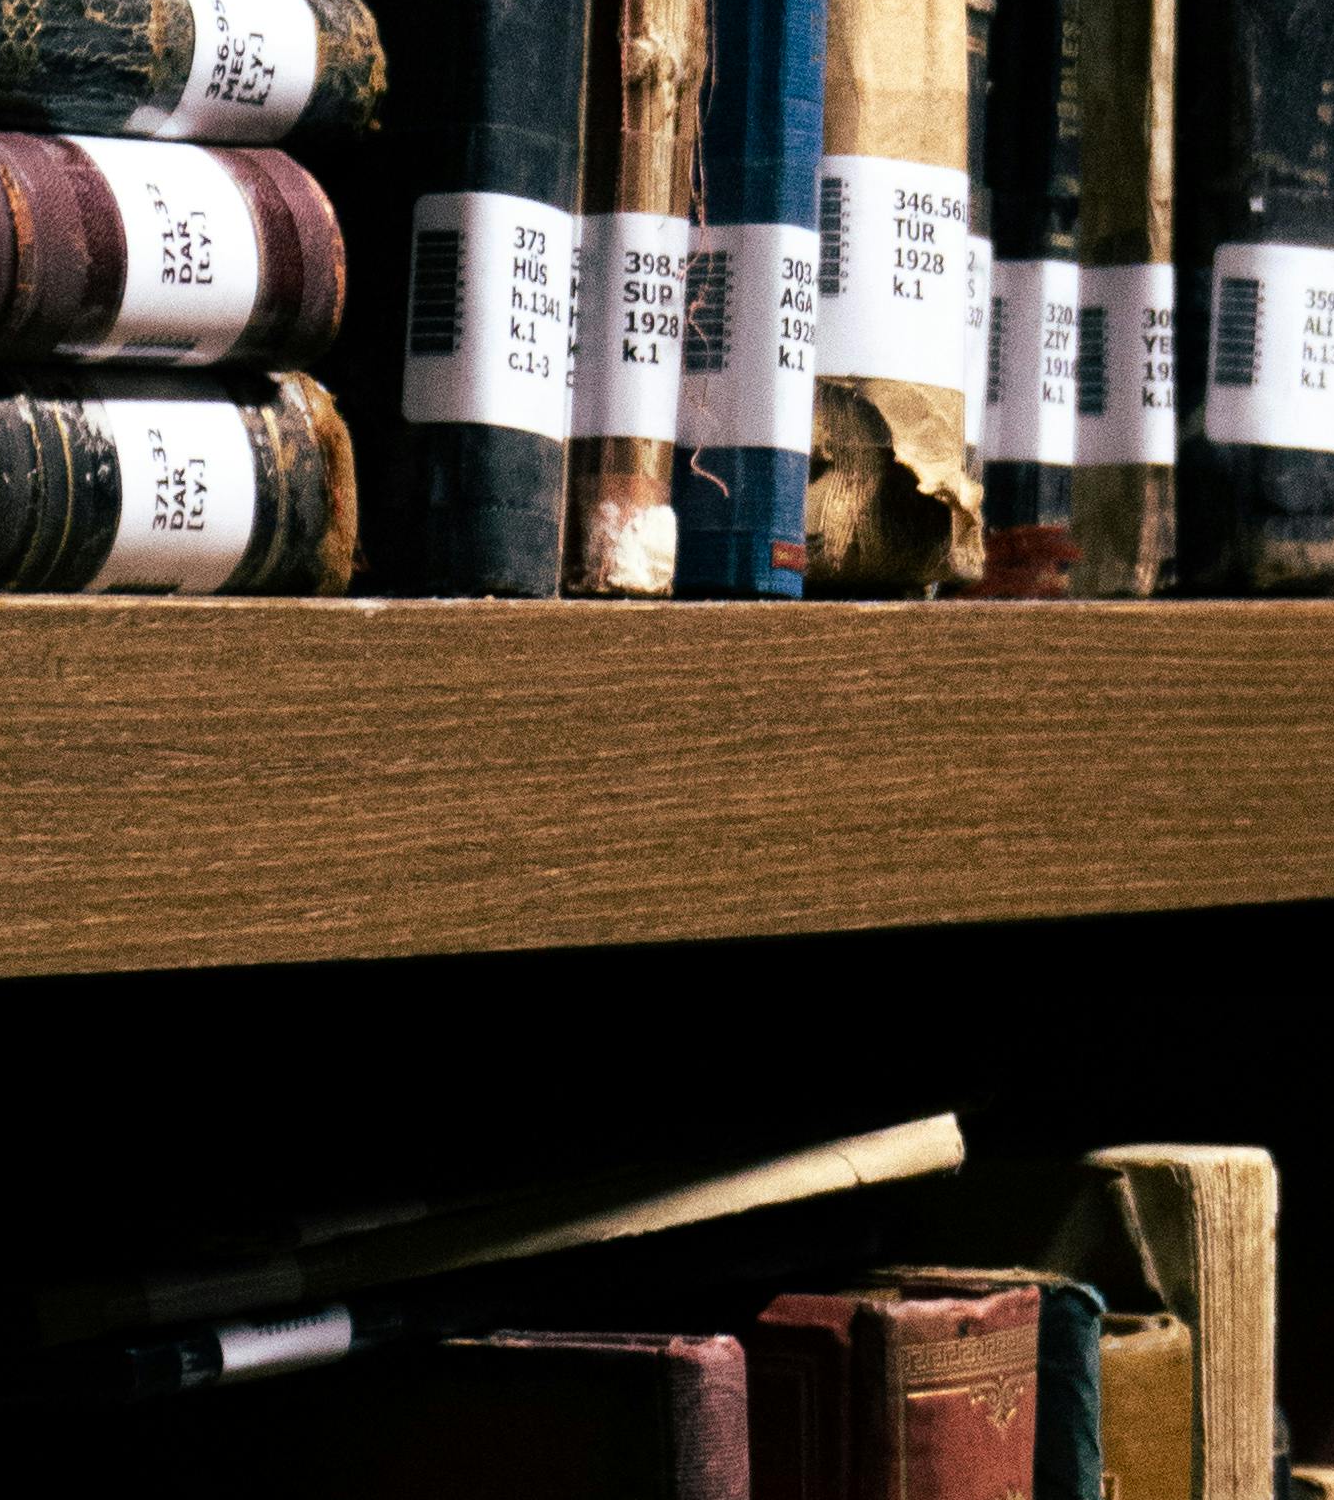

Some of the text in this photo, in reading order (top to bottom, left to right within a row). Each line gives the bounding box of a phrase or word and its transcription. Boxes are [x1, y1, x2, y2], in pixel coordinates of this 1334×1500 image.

[220, 37, 246, 102] MEC
[514, 226, 547, 255] 373
[893, 214, 937, 246] TÜR
[176, 220, 193, 285] DAR
[893, 247, 946, 276] 1928
[512, 255, 548, 287] HÜS
[622, 281, 675, 307] SUP
[779, 283, 814, 314] AĞA
[892, 277, 925, 301] k.1
[510, 288, 562, 324] h.1341
[508, 317, 538, 345] k.1
[623, 311, 681, 341] 1928
[621, 340, 661, 366] k.1
[777, 345, 806, 373] k.1
[148, 428, 170, 531] 371.32
[186, 457, 208, 532] [t.y.]
[169, 467, 187, 531] DAR
